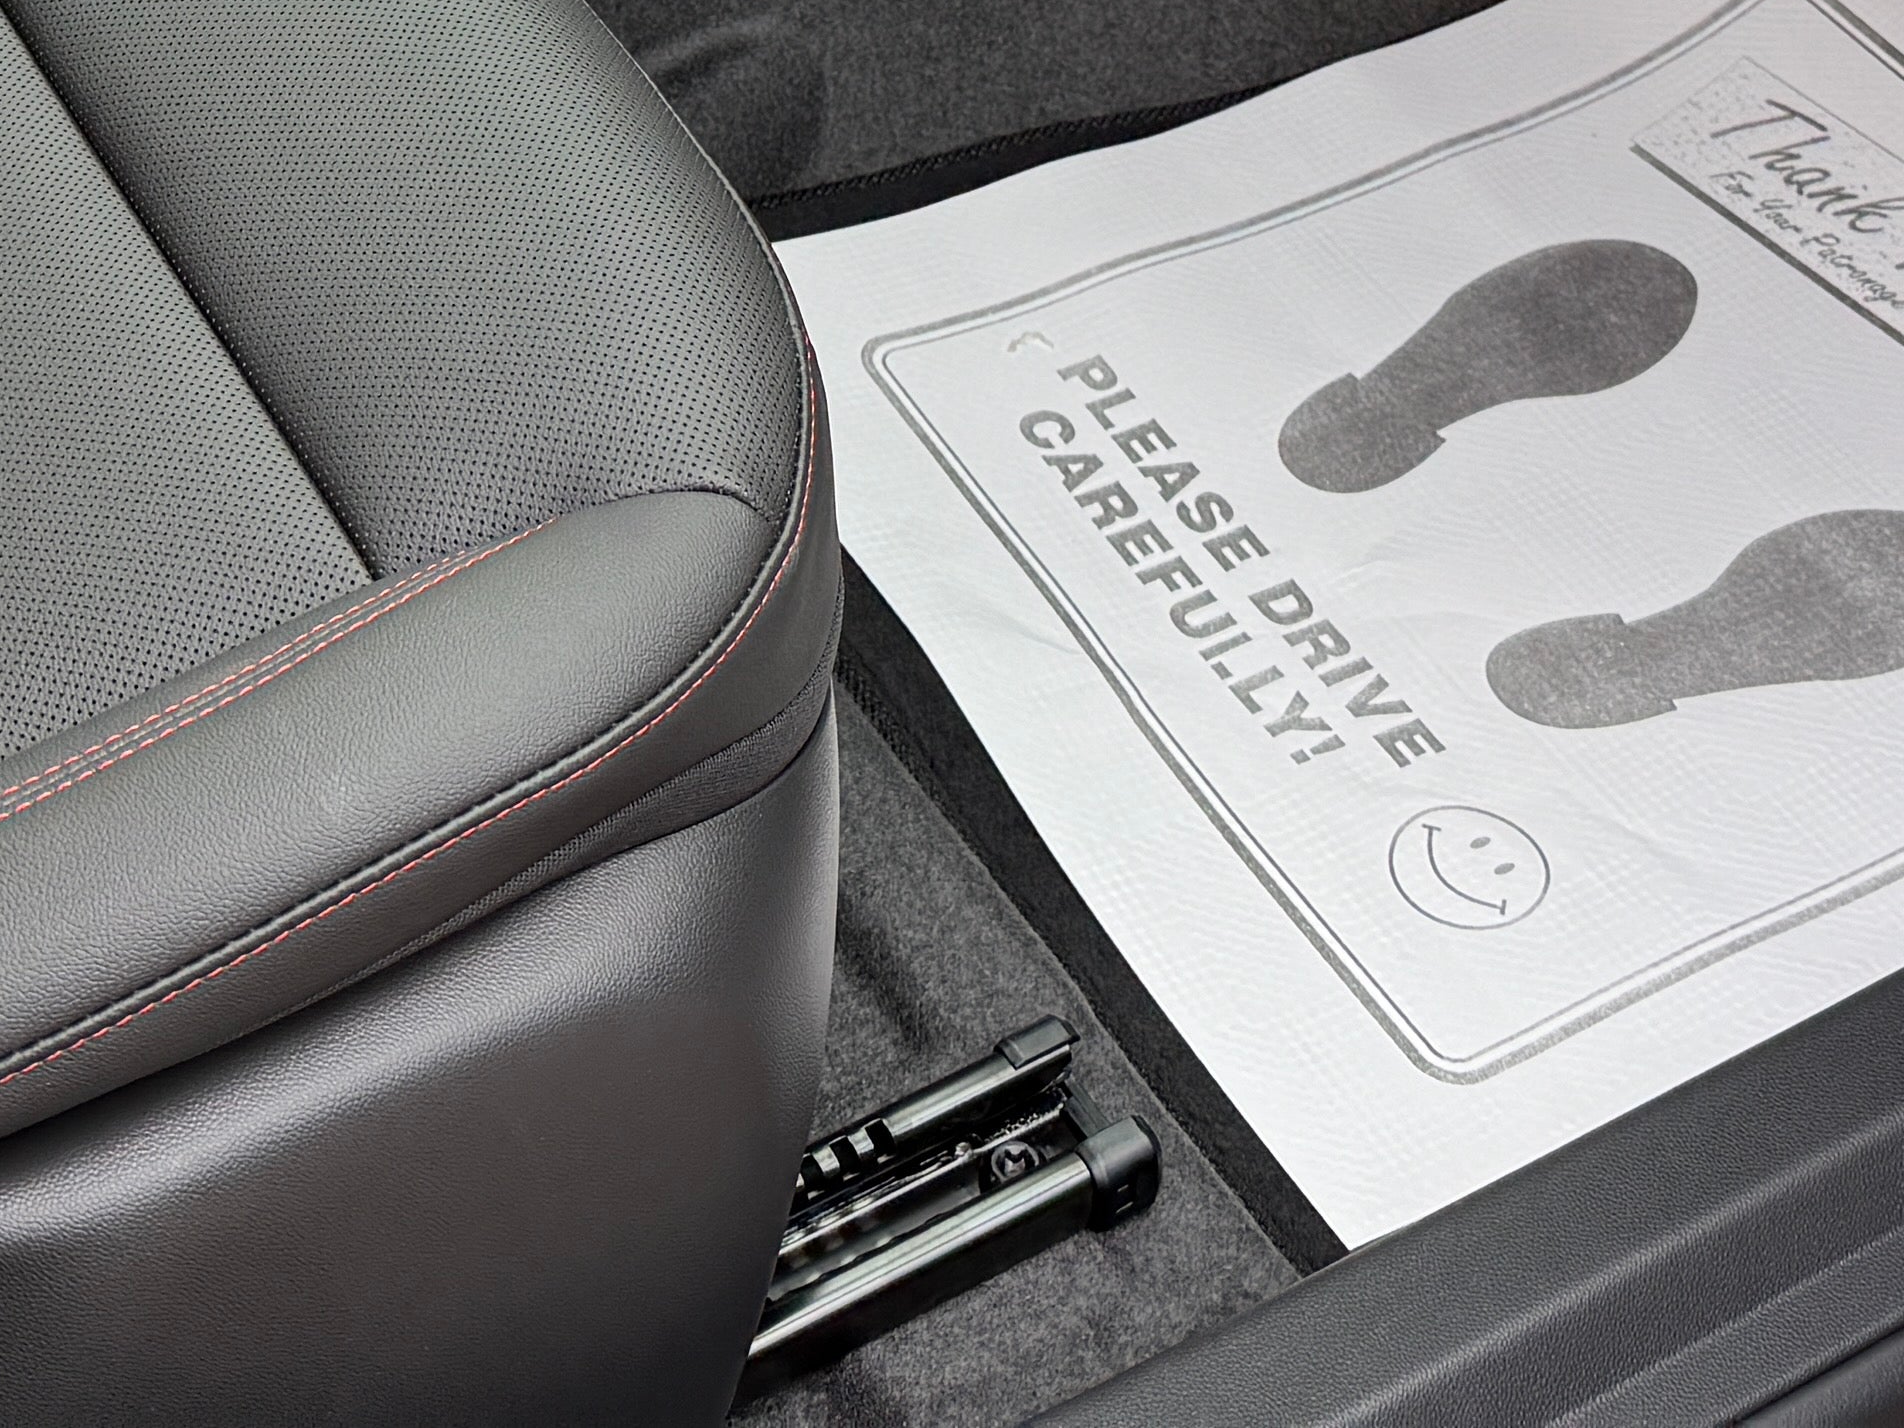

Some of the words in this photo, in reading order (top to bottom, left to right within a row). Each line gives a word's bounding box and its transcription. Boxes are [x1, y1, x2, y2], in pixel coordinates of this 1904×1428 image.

[1709, 170, 1755, 201] For
[1752, 197, 1802, 235] Your
[1018, 408, 1347, 766] CAREFULLY!
[1055, 354, 1272, 574] PLEASE
[1247, 578, 1448, 770] DRIVE
